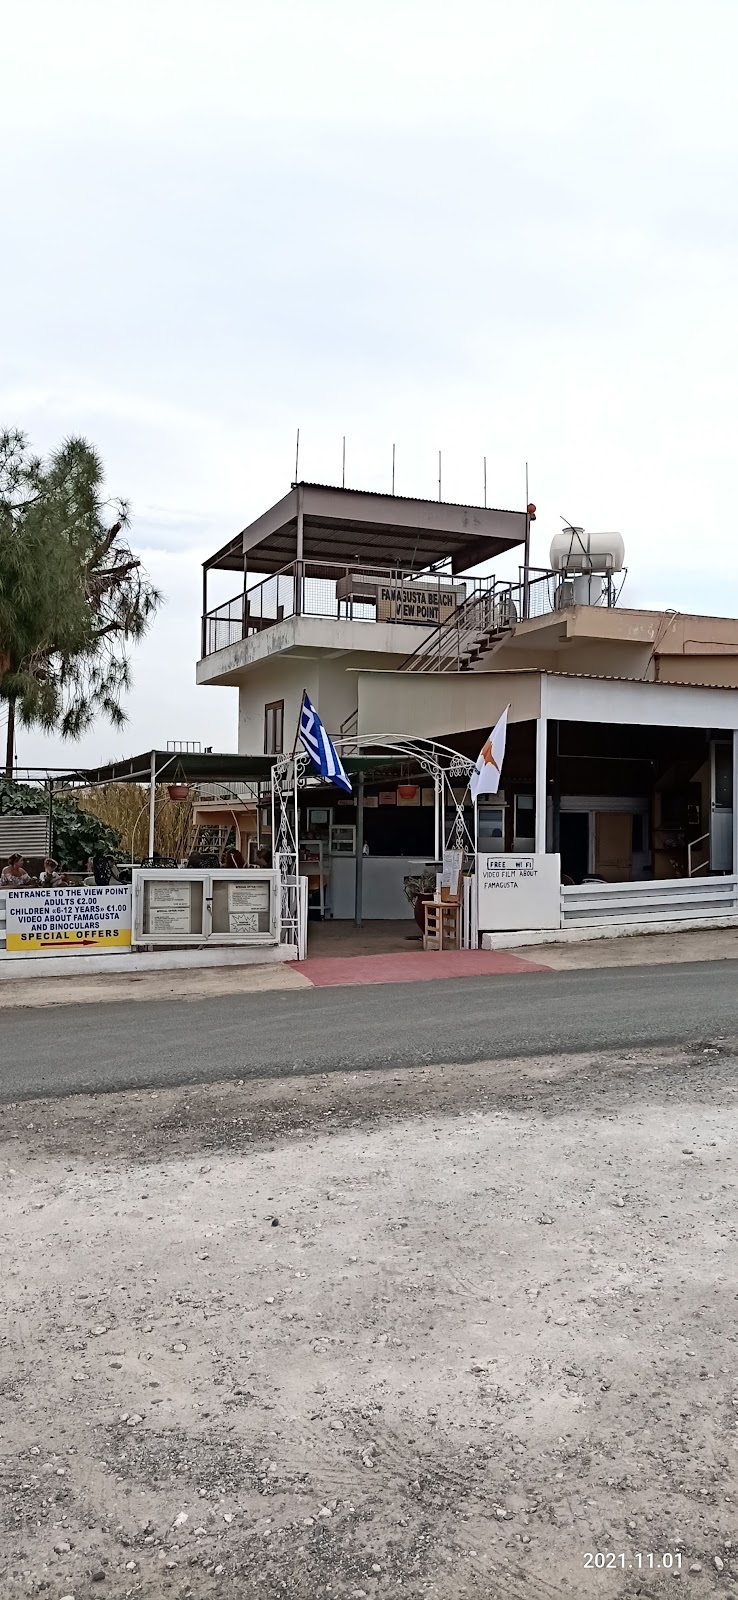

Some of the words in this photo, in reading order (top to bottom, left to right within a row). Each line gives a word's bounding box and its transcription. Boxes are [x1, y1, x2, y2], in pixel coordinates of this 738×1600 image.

[396, 603, 415, 617] VEW
[416, 605, 439, 619] POINT
[501, 870, 516, 878] FILM
[519, 869, 538, 877] ABOUT
[484, 881, 519, 889] FAMAGUSTA
[8, 890, 51, 899] ENTRANCE
[53, 889, 64, 897] TO
[66, 889, 82, 897] THE
[83, 888, 103, 896] VIEW
[105, 887, 129, 895] POINT
[44, 898, 75, 906] ADULTS
[76, 897, 97, 905] €2.00
[10, 907, 50, 916] CHILDREN
[106, 904, 127, 912] €1.00
[18, 915, 43, 923] VIDEO
[44, 914, 72, 922] ABOUT
[73, 912, 120, 921] FAMAGUSTA
[49, 921, 100, 931] BINOCULARS
[20, 931, 70, 941] SPECIAL
[76, 929, 120, 939] OFFERS
